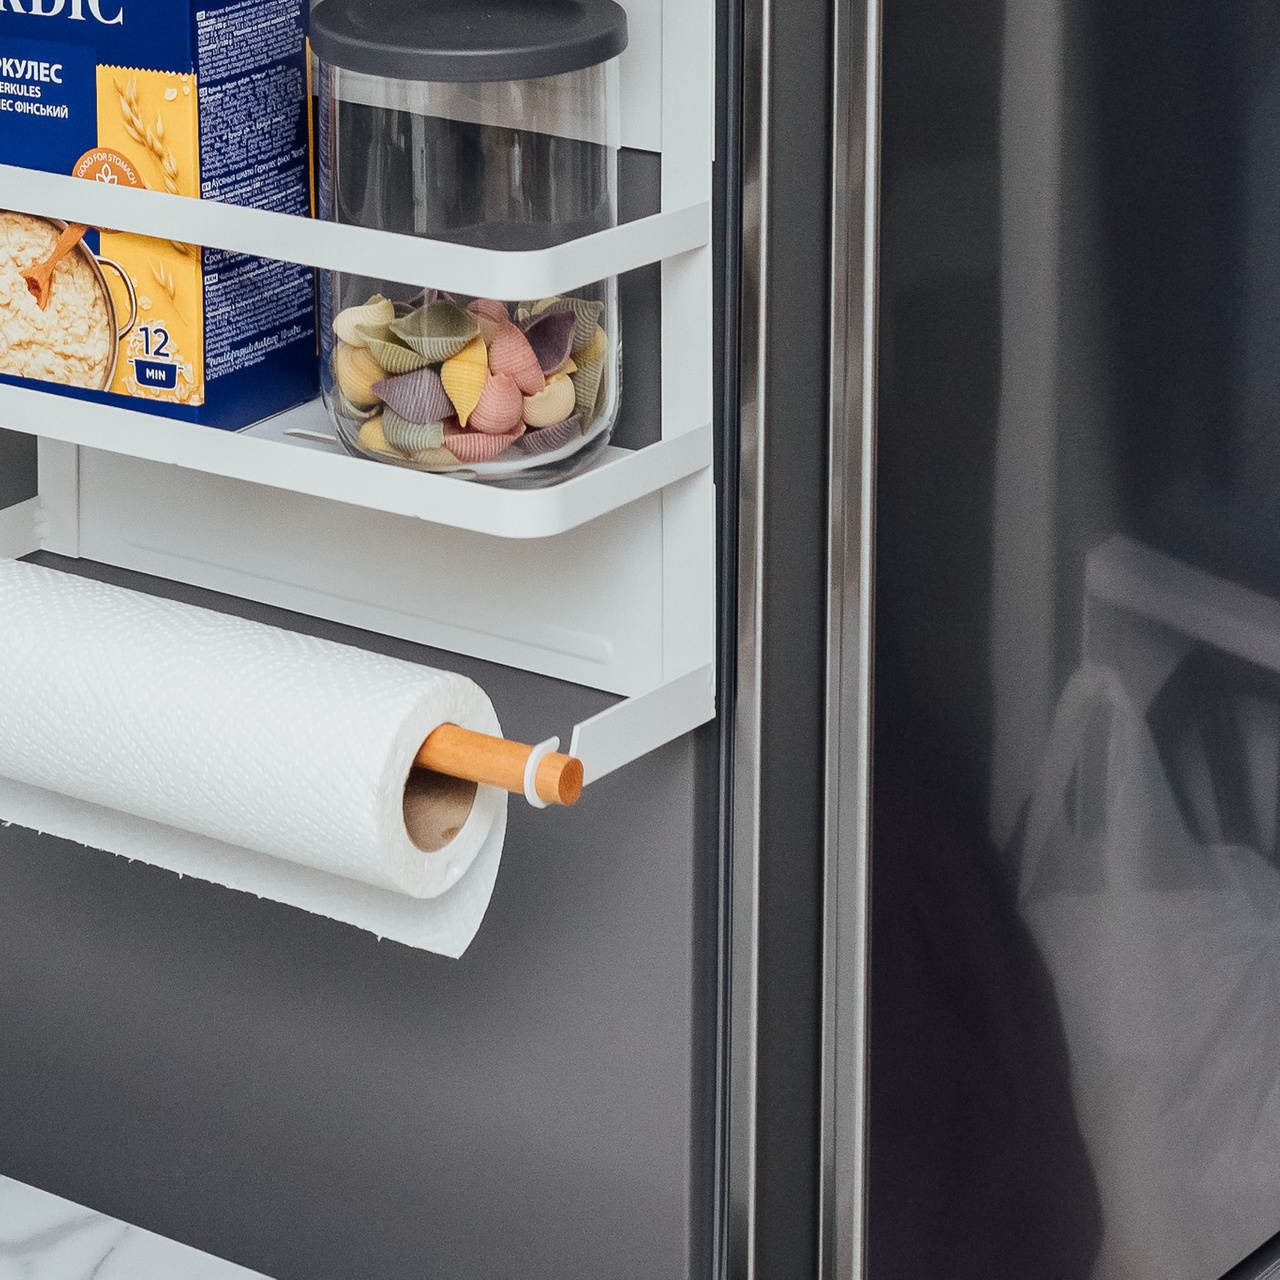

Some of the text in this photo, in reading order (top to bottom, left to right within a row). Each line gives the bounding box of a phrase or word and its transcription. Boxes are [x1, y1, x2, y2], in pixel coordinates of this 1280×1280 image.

[14, 101, 69, 119] ФІНСЬКИЙ
[77, 153, 137, 185] GOOD FOR STOMACH
[139, 327, 169, 357] 12
[146, 368, 166, 381] MIN
